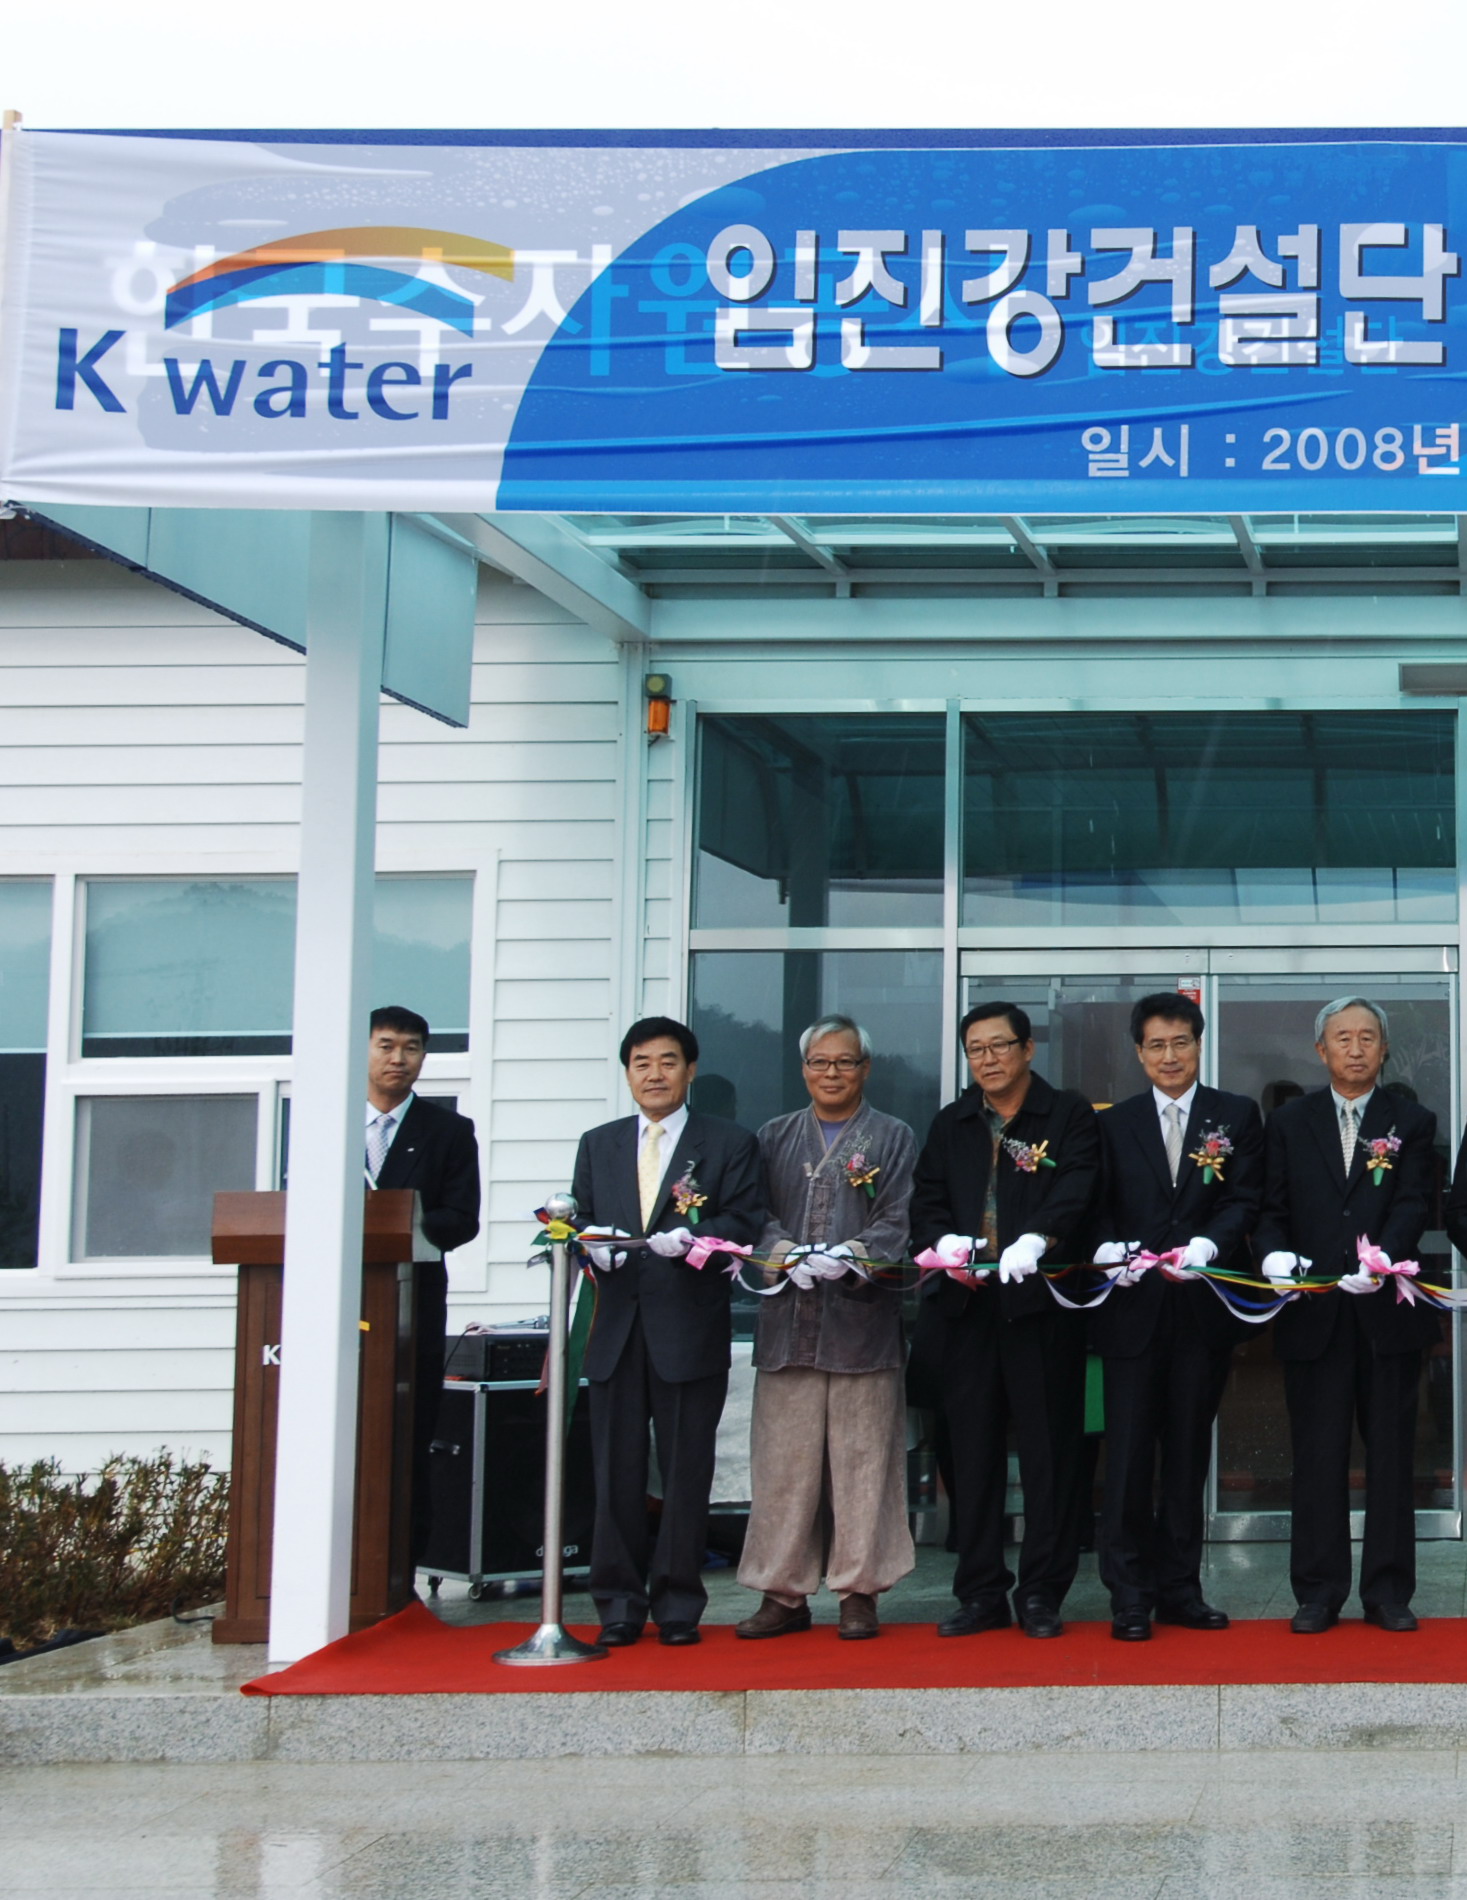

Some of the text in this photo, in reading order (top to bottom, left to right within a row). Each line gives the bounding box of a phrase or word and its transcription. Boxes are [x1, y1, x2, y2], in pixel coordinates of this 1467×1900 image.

[706, 224, 1460, 377] 임진강건설단
[54, 327, 474, 421] K water
[1081, 424, 1190, 478] 일시
[1261, 423, 1462, 476] 2008년
